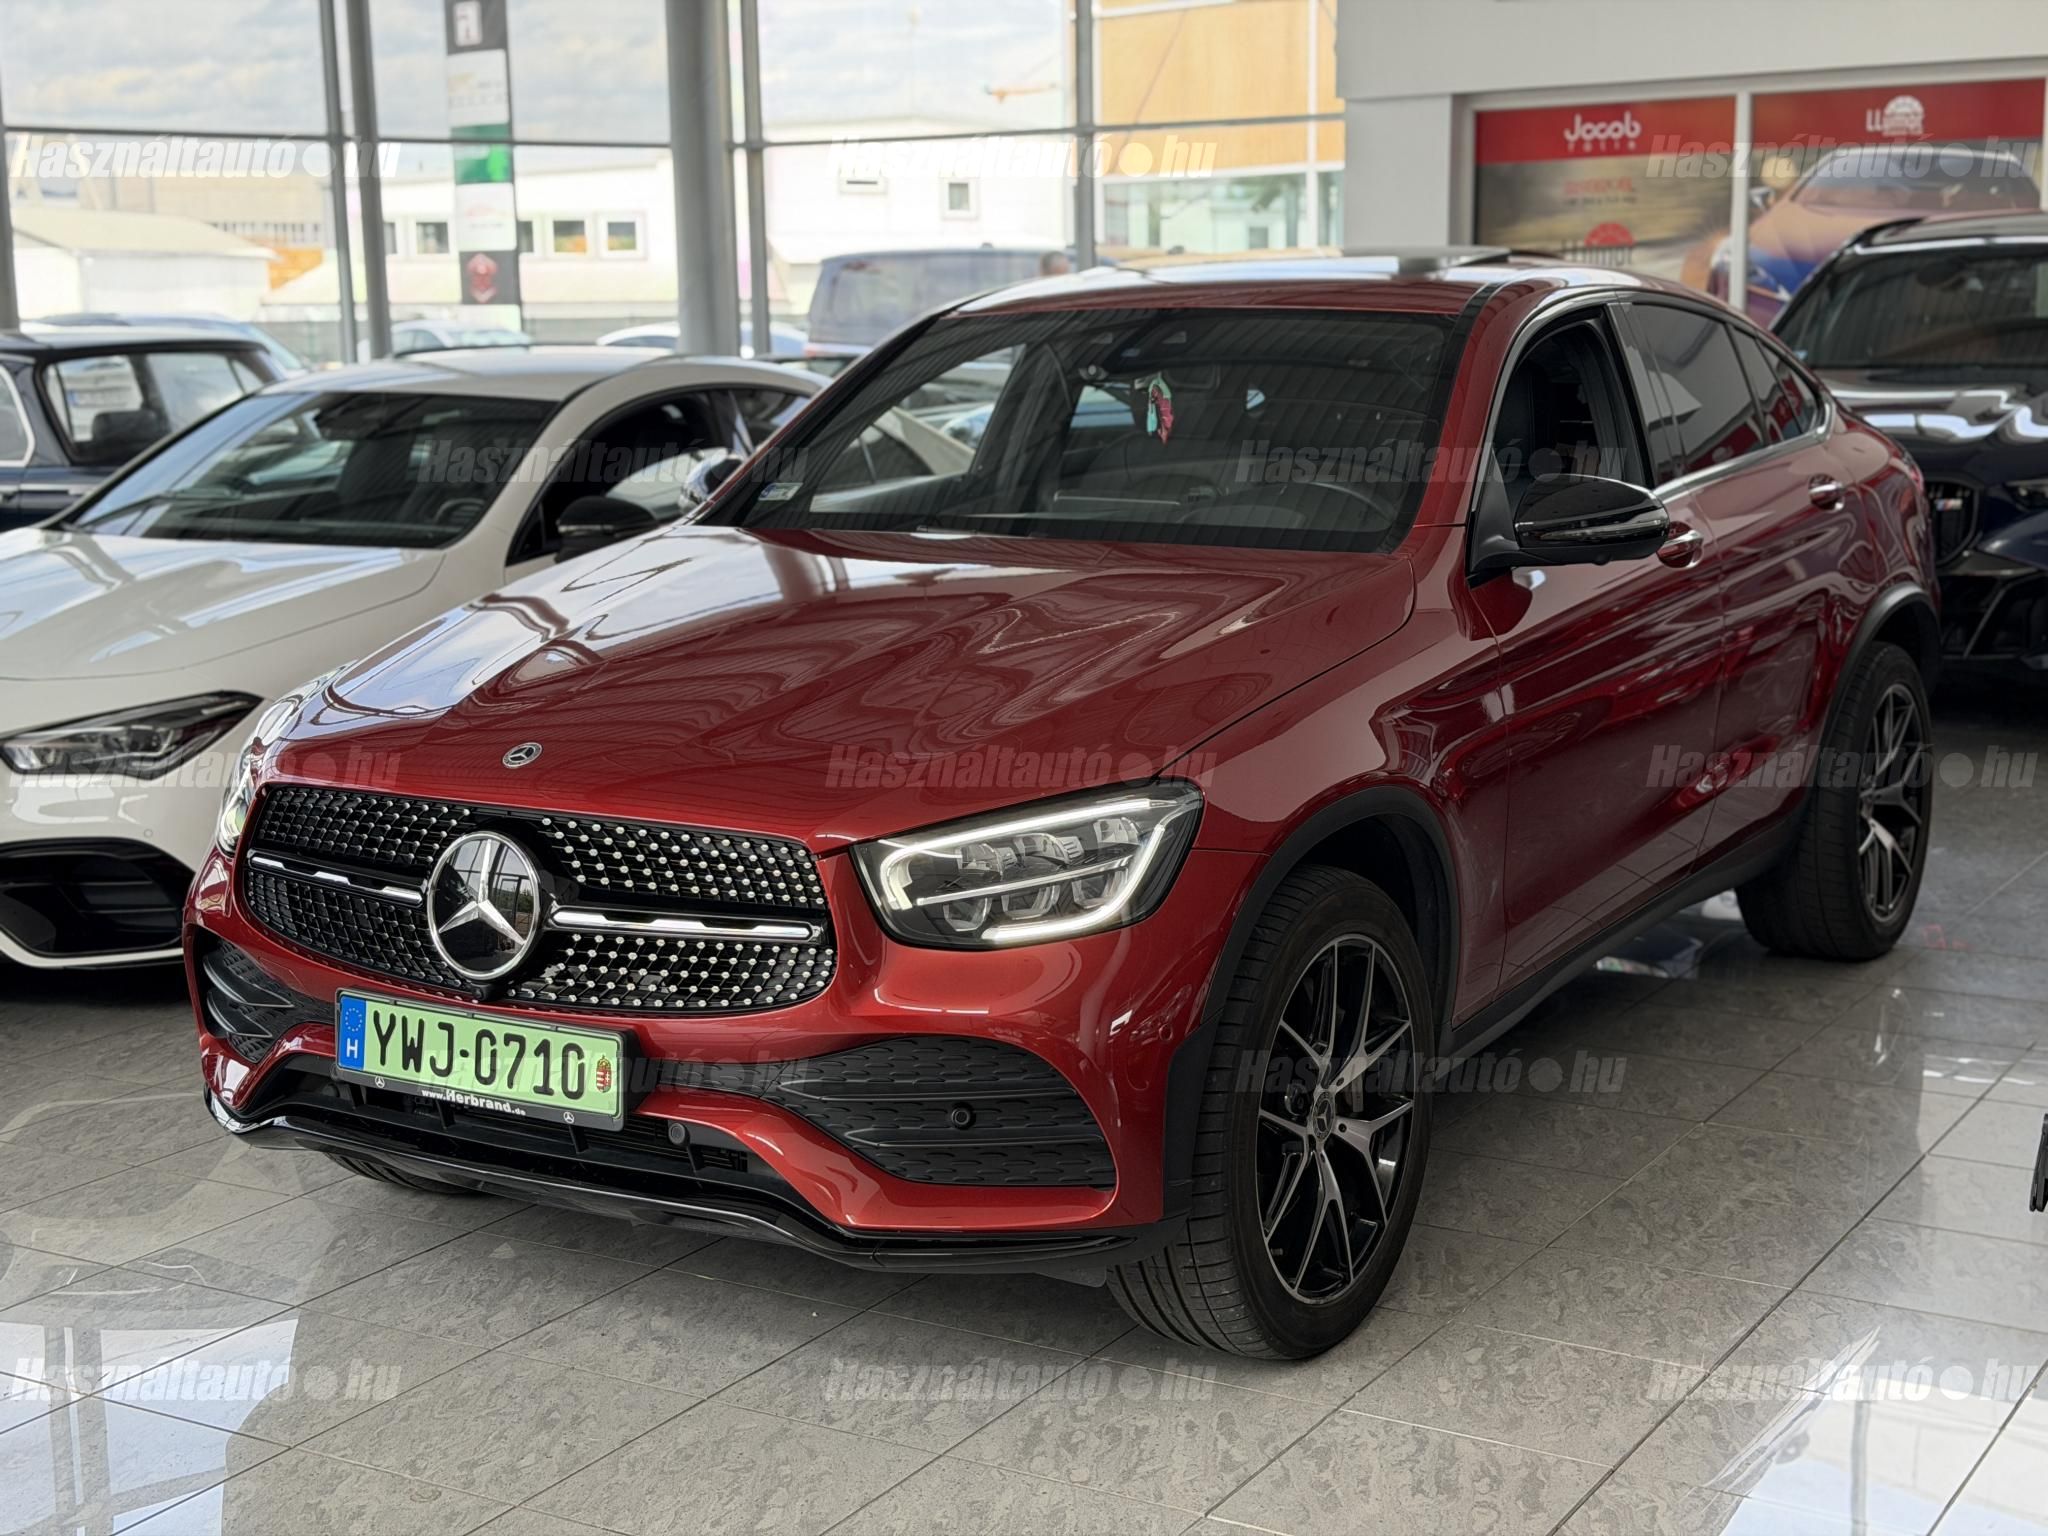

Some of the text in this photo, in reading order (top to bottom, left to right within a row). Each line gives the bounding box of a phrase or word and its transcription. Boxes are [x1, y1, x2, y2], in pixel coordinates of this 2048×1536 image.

[346, 1037, 359, 1059] H
[373, 1009, 586, 1100] YWJ-0710
[421, 1087, 527, 1116] www.Herbrand.de
